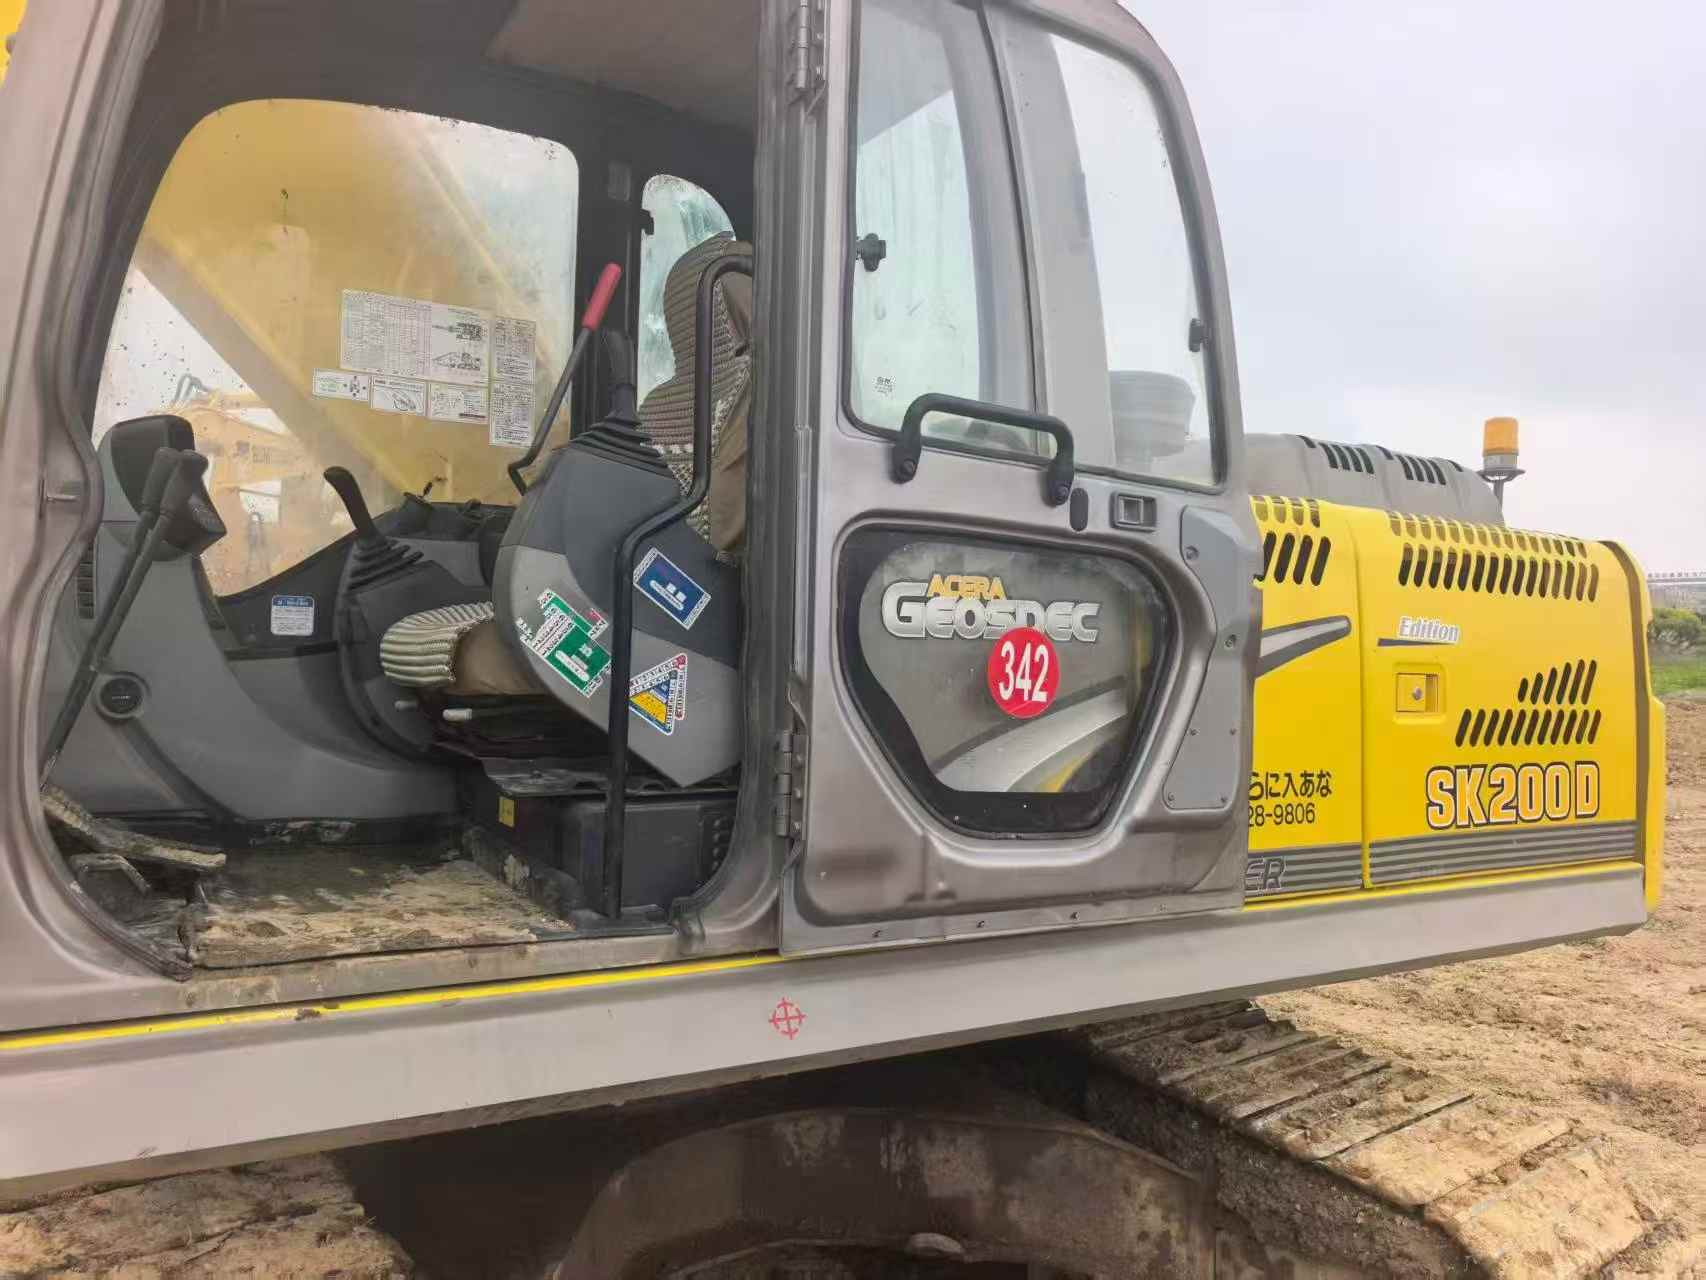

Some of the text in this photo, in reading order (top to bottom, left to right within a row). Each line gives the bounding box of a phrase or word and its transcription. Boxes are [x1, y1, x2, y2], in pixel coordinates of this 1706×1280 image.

[927, 574, 1006, 601] ACERA
[1399, 616, 1459, 643] Edition
[998, 640, 1049, 703] 342
[1426, 761, 1600, 830] SK200D
